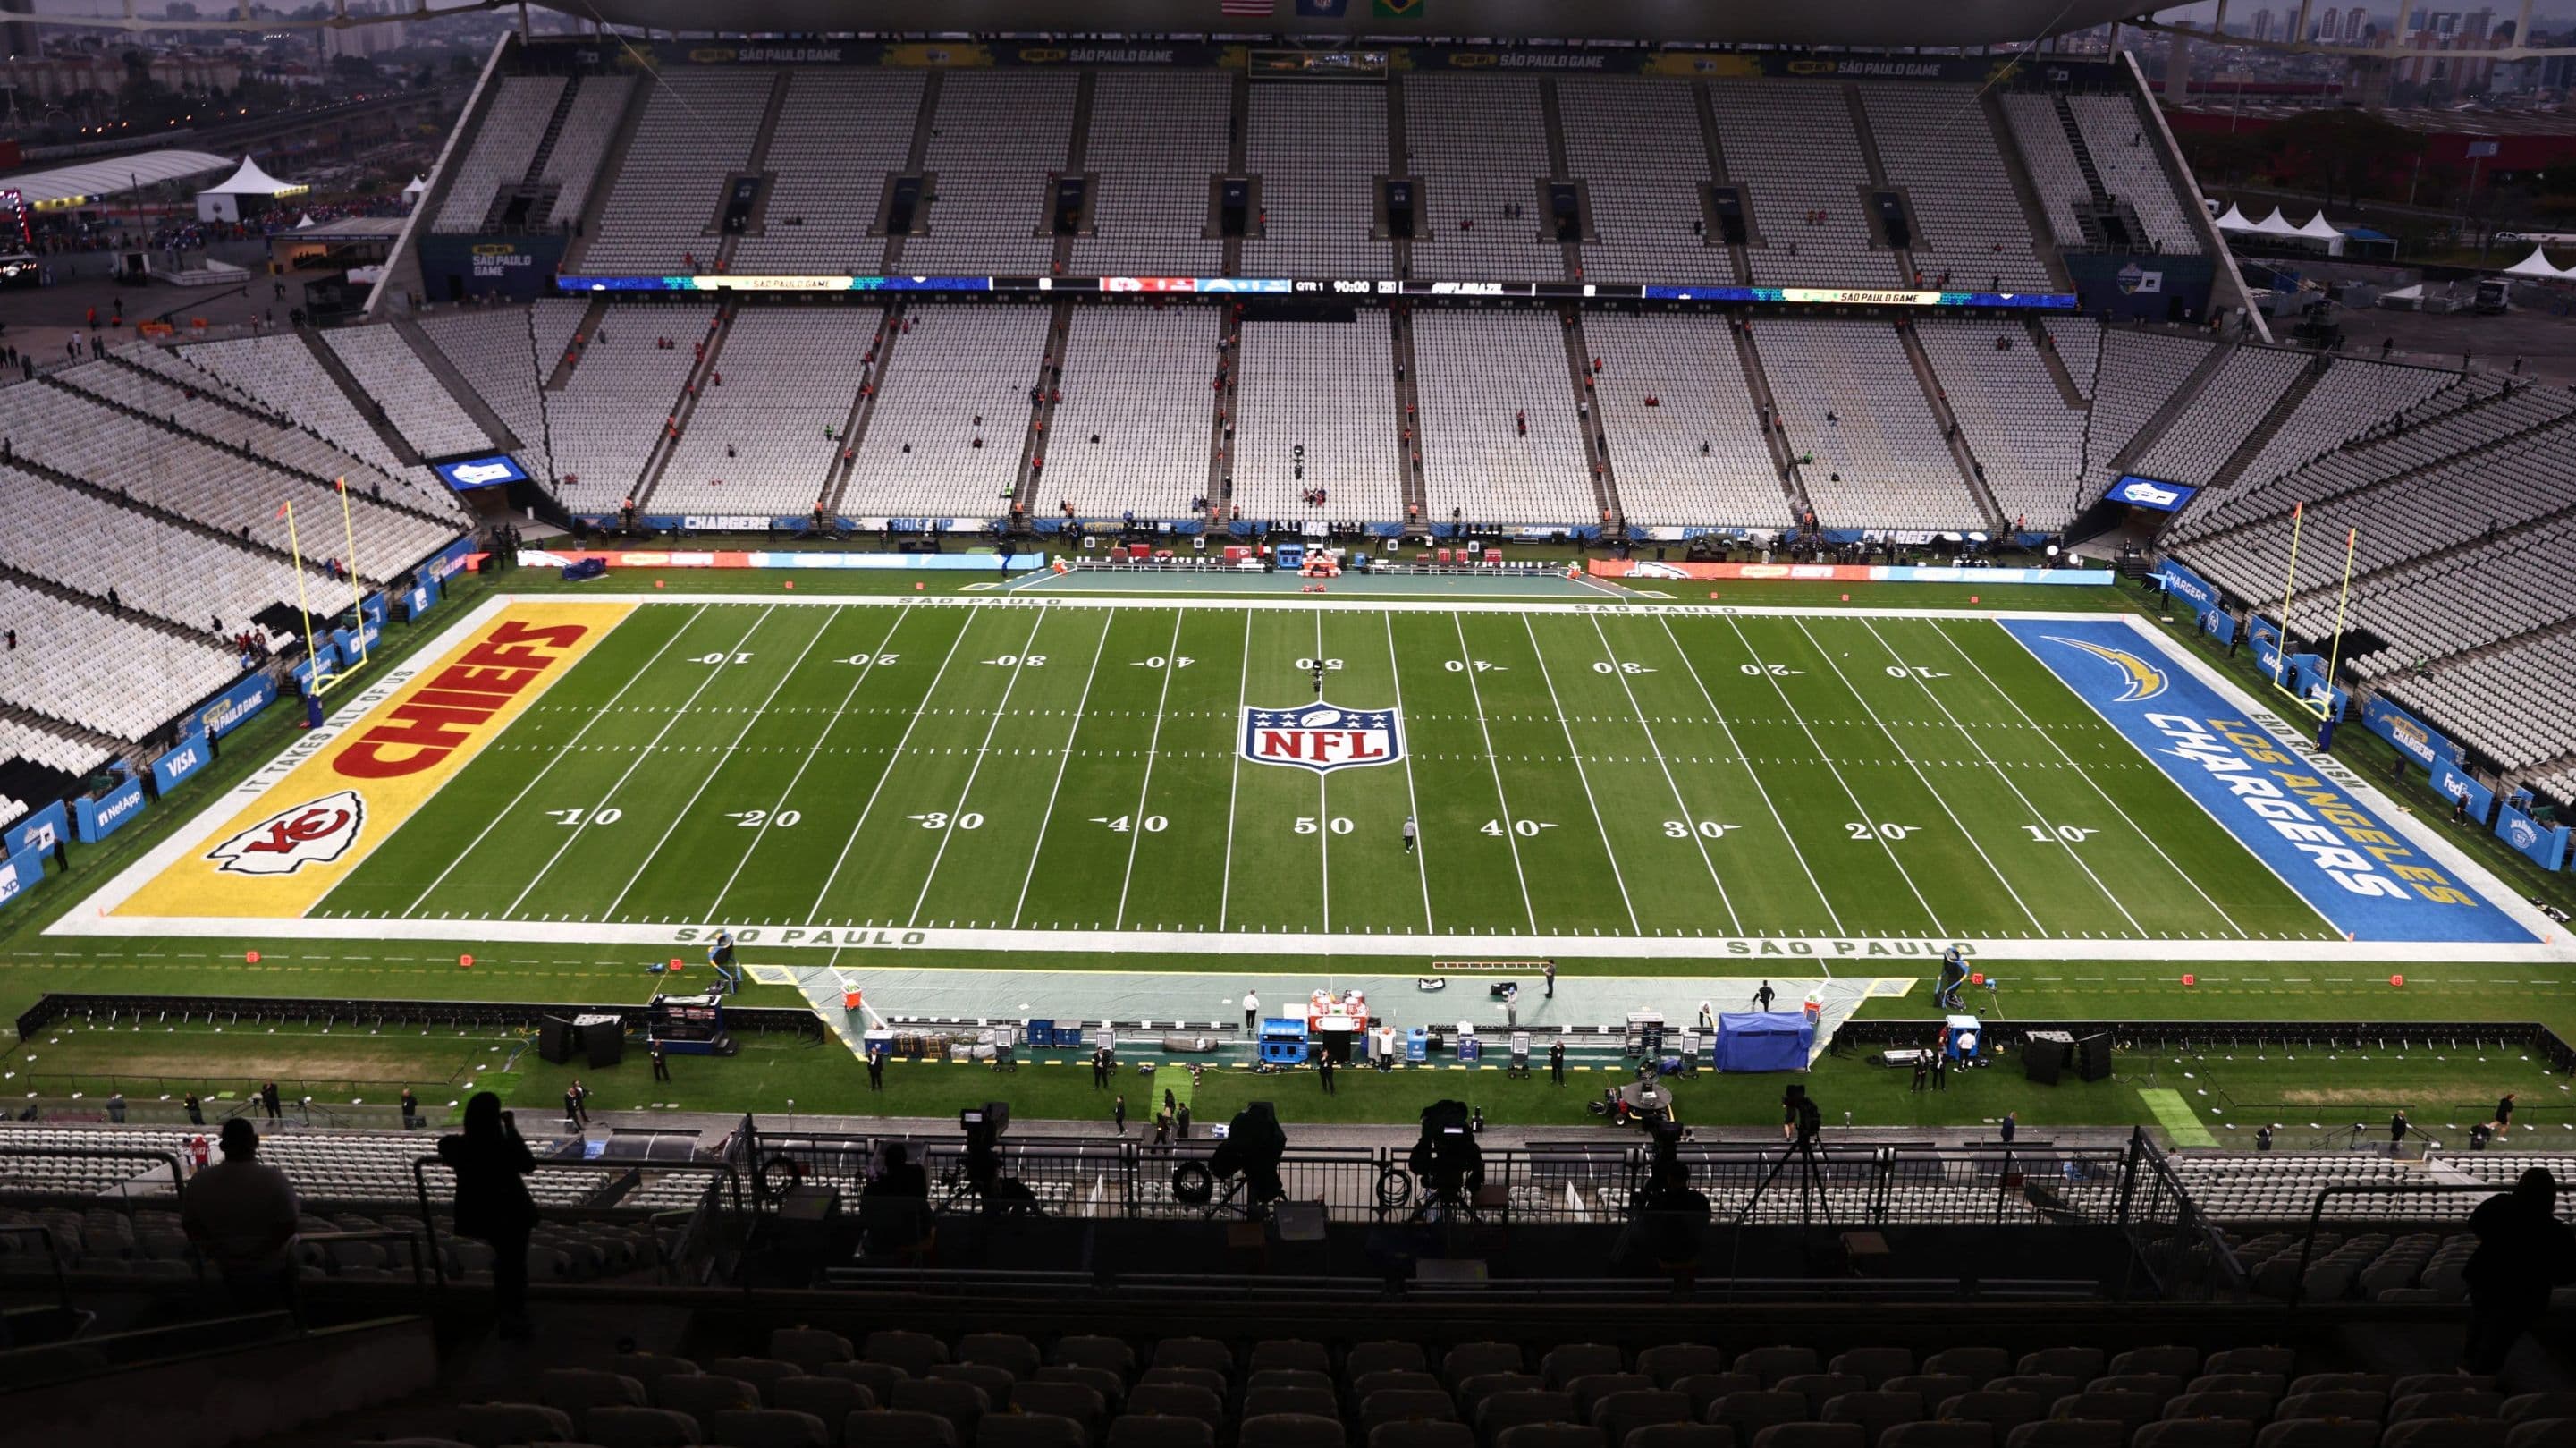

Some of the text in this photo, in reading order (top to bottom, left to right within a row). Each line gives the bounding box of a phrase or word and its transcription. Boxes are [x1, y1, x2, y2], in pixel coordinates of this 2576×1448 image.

[766, 48, 806, 60] PAULO
[807, 49, 842, 60] GAME
[1096, 49, 1136, 62] PAULO
[1138, 50, 1173, 62] GAME
[1526, 55, 1566, 67] PAULO
[1567, 55, 1603, 68] GAME
[1865, 62, 1905, 75] PAULO
[1905, 64, 1939, 77] GAME
[496, 254, 532, 266] PAULO
[473, 266, 504, 277] GAME
[1296, 282, 1316, 292] QTR
[1318, 282, 1323, 292] 1
[1333, 280, 1370, 293] 90:00
[1862, 293, 1891, 302] PAULO
[1893, 293, 1920, 303] GAME
[684, 516, 771, 530] CHARGERS
[891, 518, 929, 531] BOLT
[968, 597, 1061, 606] PAULO
[1644, 605, 1737, 614] PAULO
[333, 621, 587, 778] CHIEFS
[220, 703, 243, 729] PAULO
[242, 690, 263, 714] GAME
[239, 670, 415, 792] IT TAKES ALL OF US
[1261, 731, 1383, 762] NFL
[2250, 714, 2369, 791] END RACISM
[2392, 727, 2436, 763] CHARGERS
[165, 748, 198, 777] VISA
[107, 792, 141, 819] NetApp
[2144, 712, 2411, 900] CHARGERS
[2205, 719, 2479, 907] LOS ANGELES
[2, 879, 20, 897] xp
[780, 930, 925, 946] PAULO
[1726, 938, 1976, 957] SÃO PAULO
